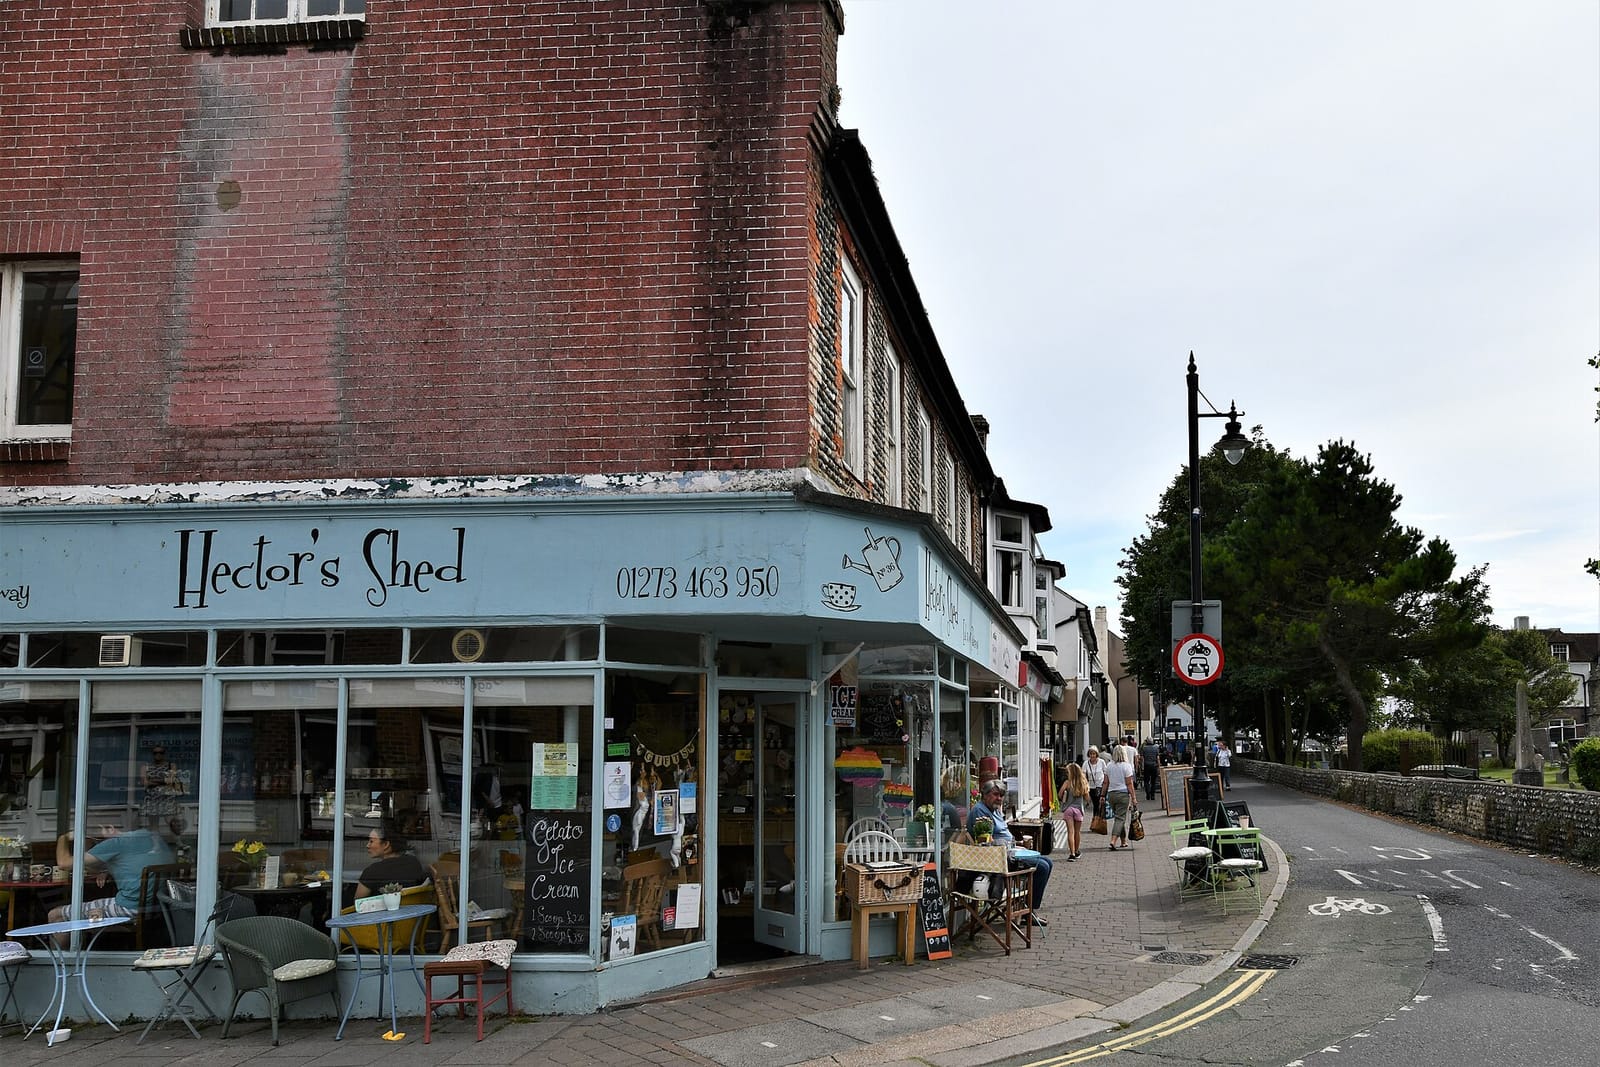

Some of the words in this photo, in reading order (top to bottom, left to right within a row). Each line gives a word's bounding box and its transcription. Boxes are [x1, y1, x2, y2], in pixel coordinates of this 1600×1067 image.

[173, 528, 340, 609] Hector's
[362, 527, 468, 608] Shed
[616, 566, 678, 599] 01273
[684, 566, 729, 598] 463
[736, 565, 780, 598] 950
[831, 686, 857, 708] ICE
[532, 819, 583, 864] Gelato
[550, 843, 574, 874] Ice
[531, 874, 580, 900] Cream
